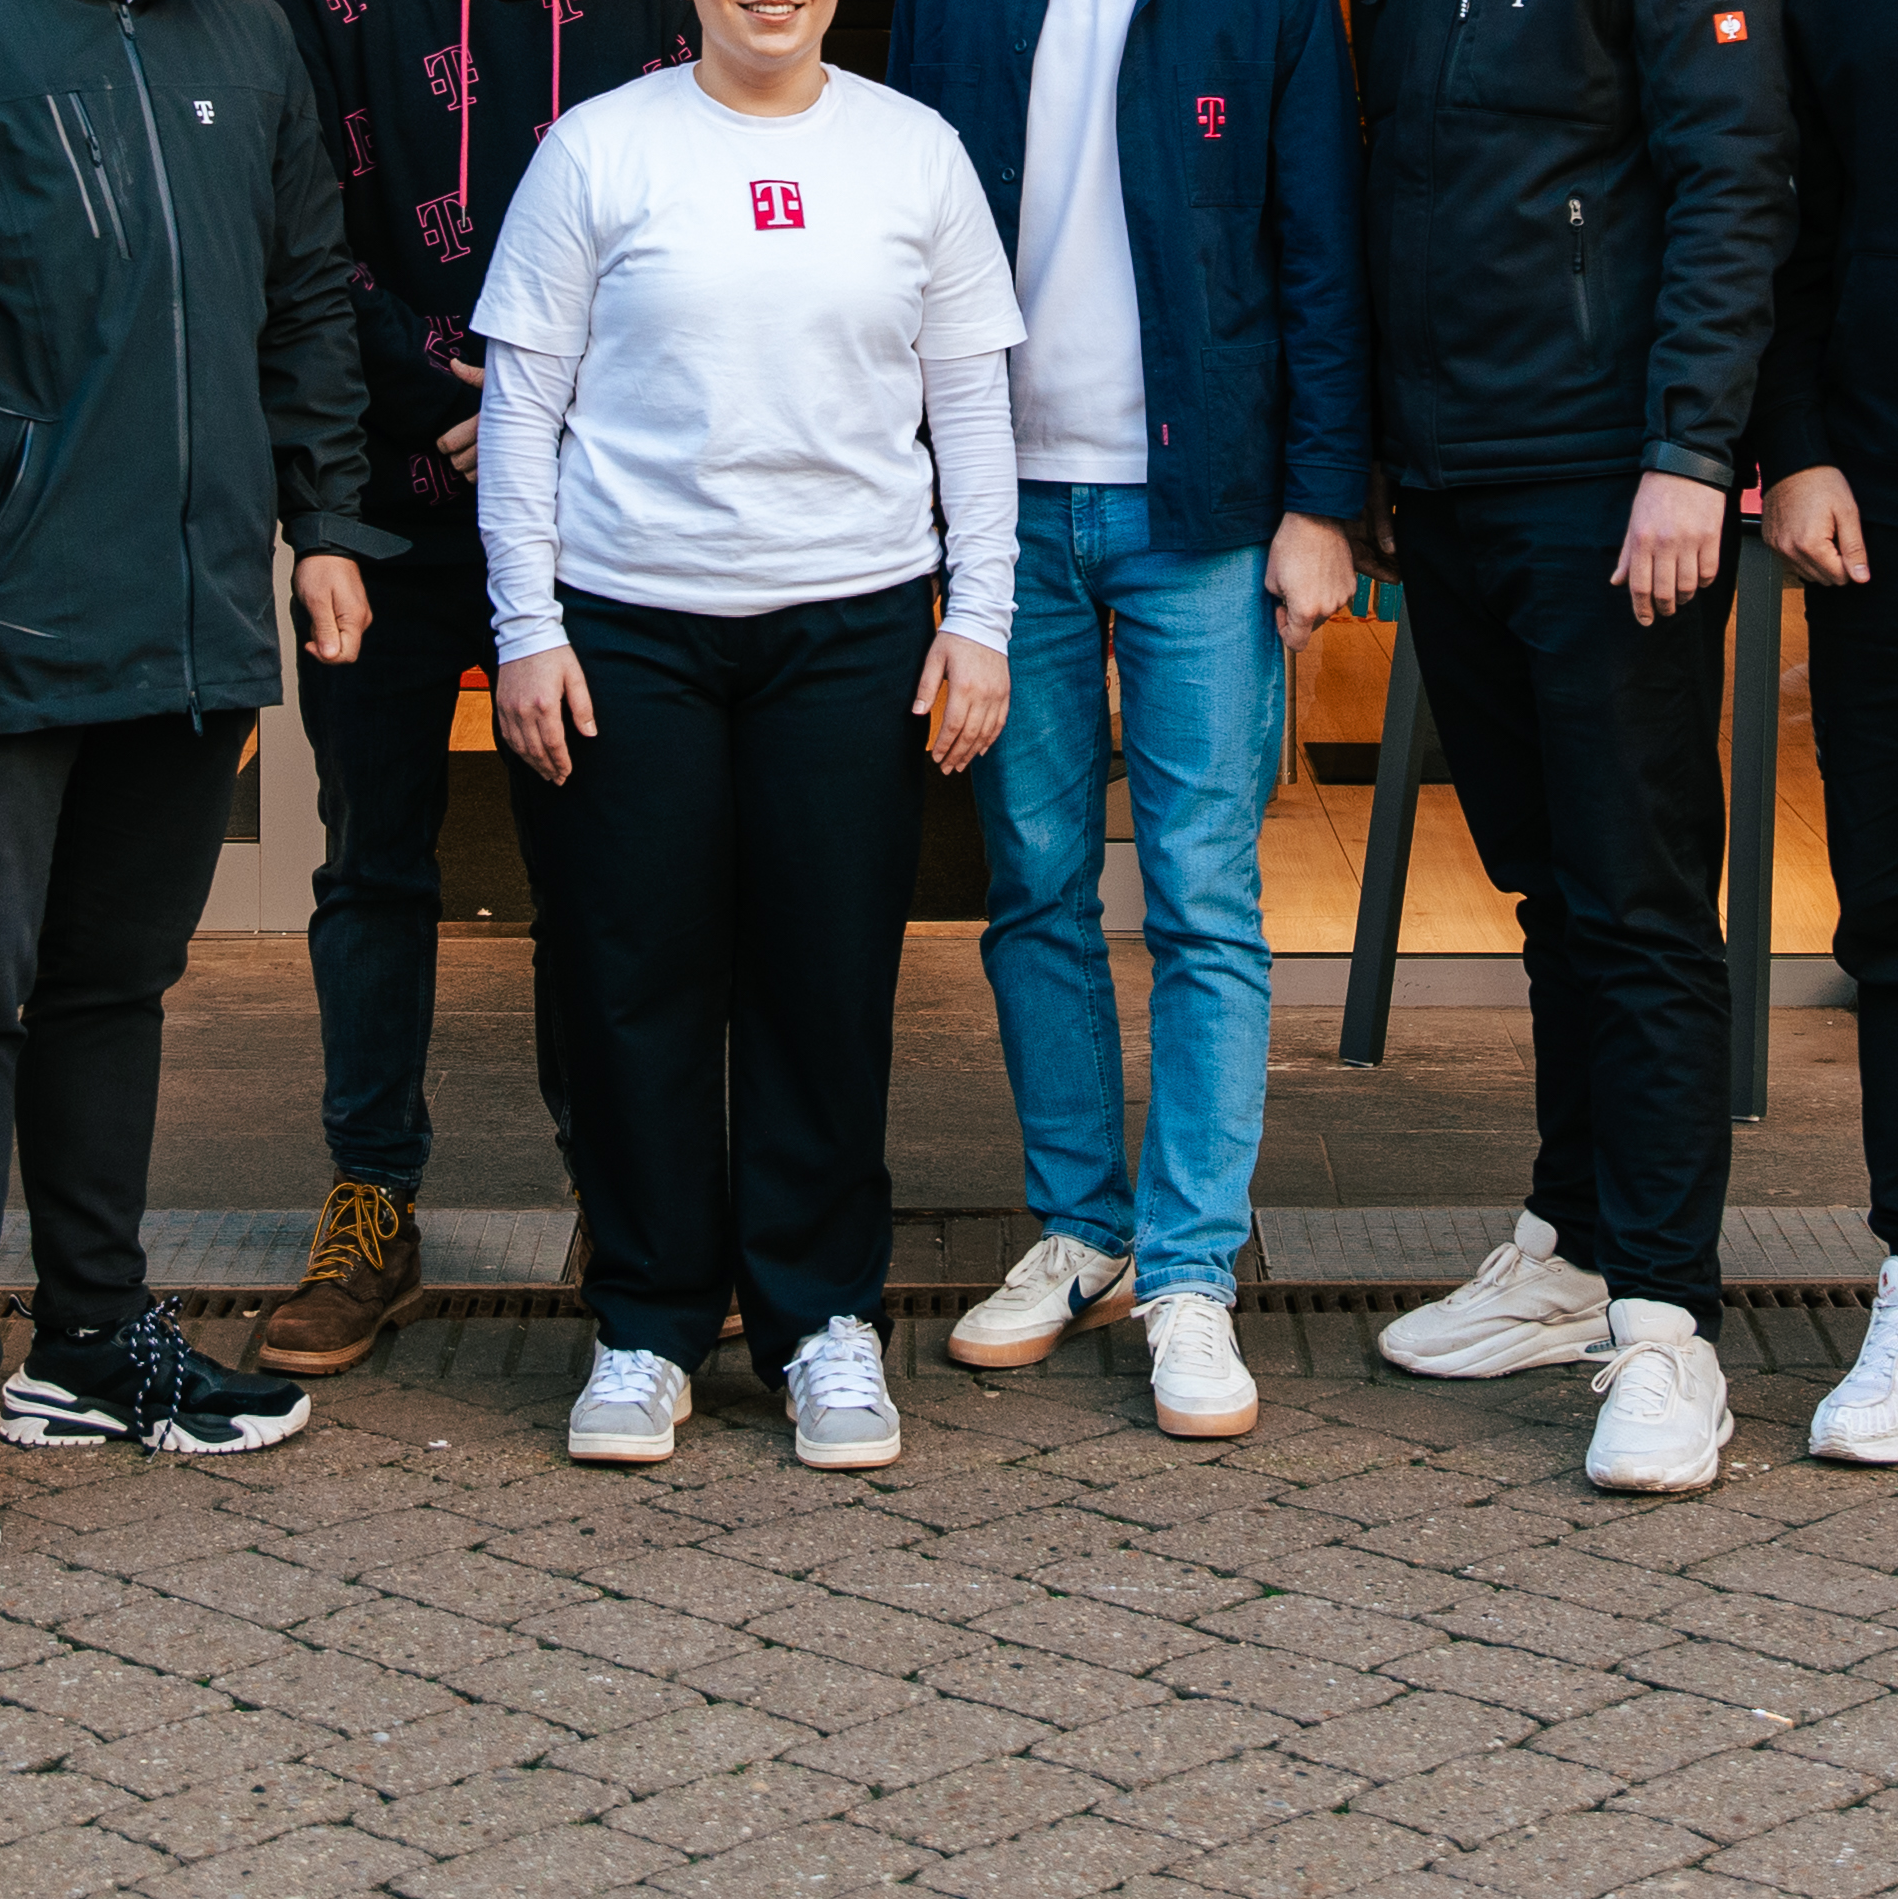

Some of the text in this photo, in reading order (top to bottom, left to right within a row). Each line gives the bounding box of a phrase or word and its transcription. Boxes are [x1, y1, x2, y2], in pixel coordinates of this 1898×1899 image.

[423, 43, 480, 112] T
[193, 100, 215, 125] T
[1196, 96, 1226, 138] T
[755, 182, 800, 226] T
[416, 190, 474, 263] T
